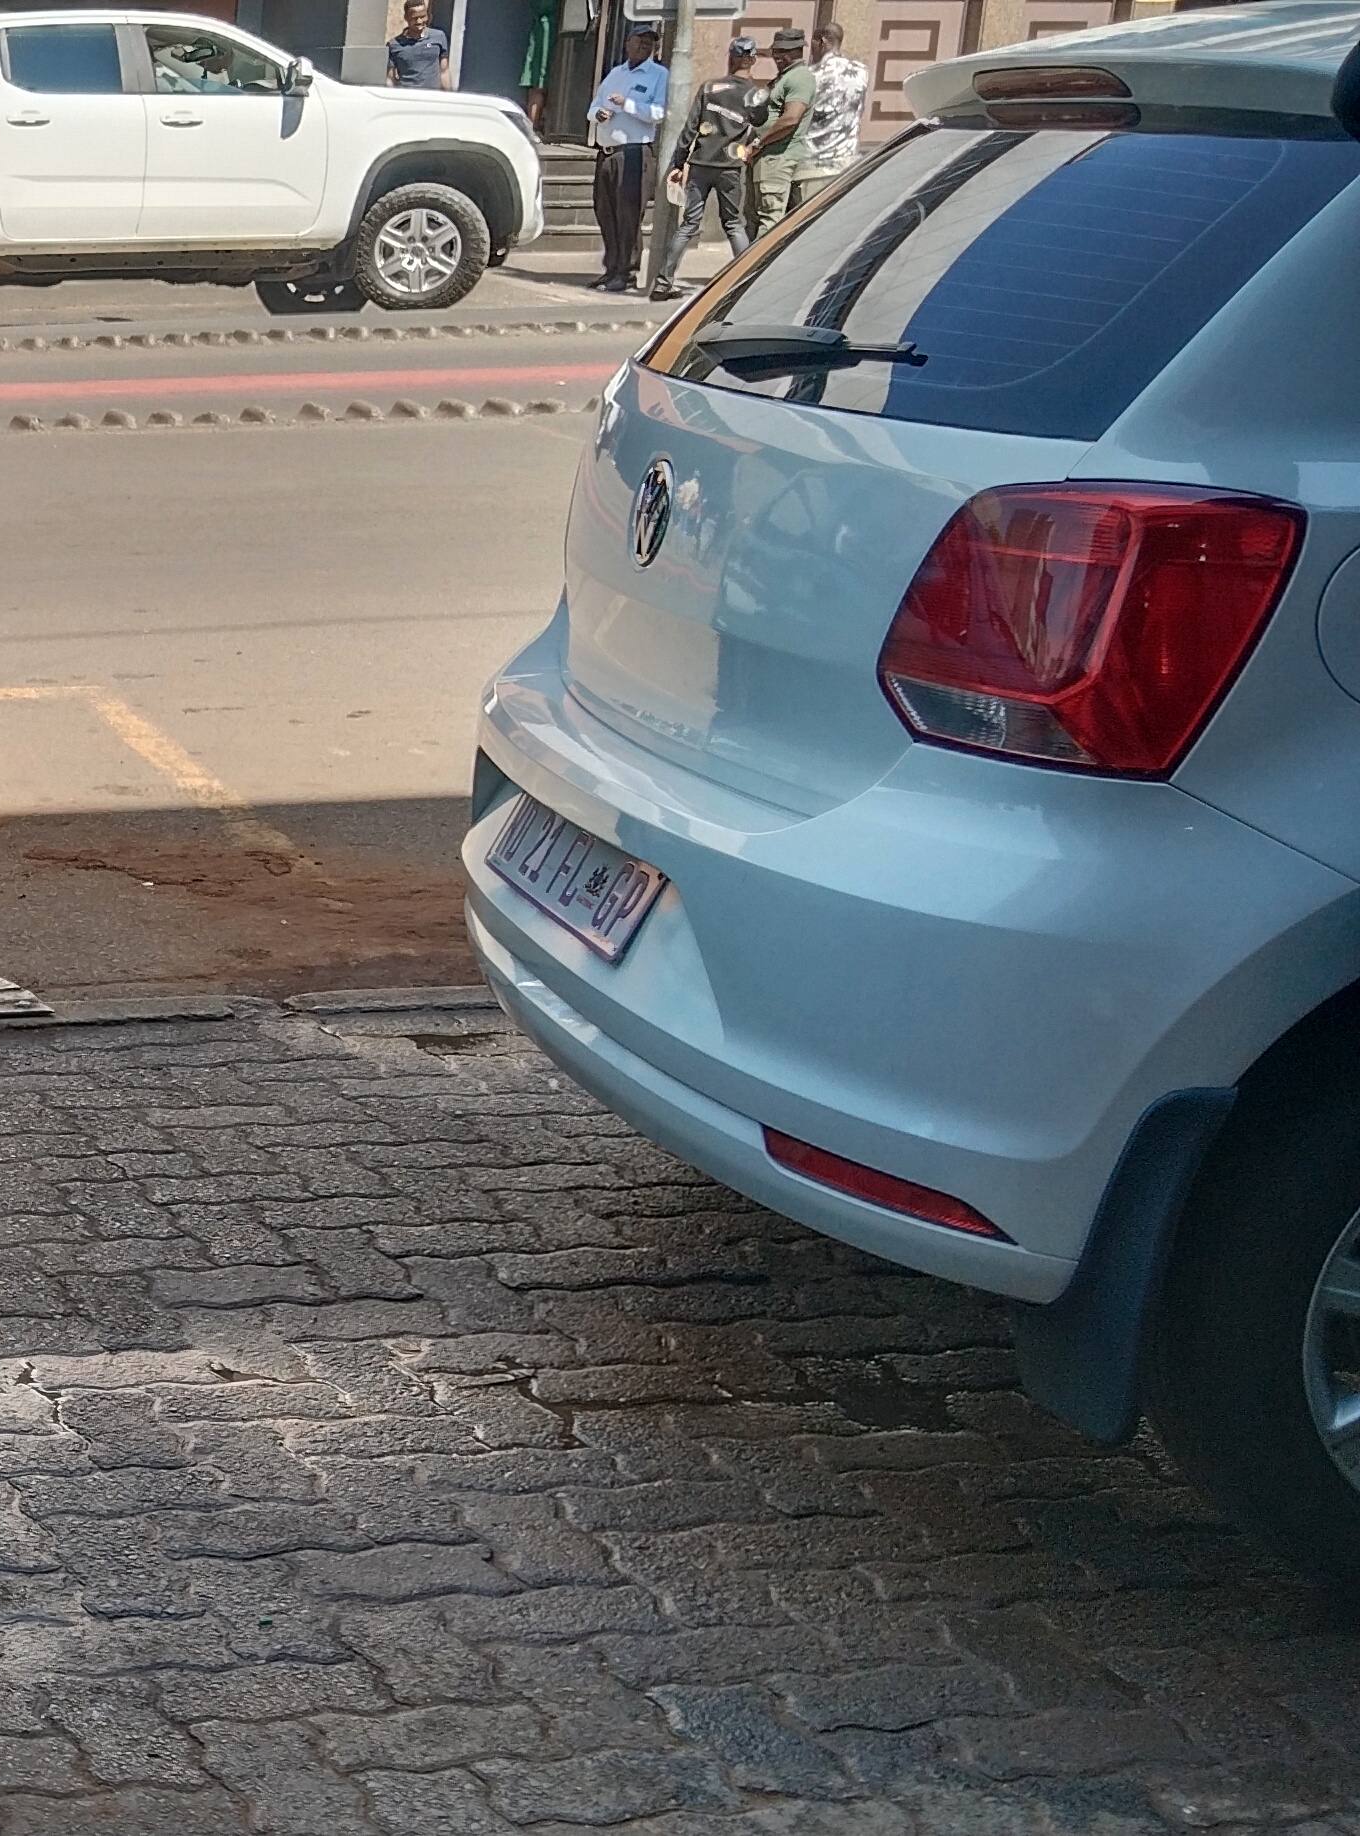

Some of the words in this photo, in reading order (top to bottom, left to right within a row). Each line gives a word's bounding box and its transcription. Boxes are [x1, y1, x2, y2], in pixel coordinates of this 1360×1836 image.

[518, 812, 567, 884] 21
[545, 830, 596, 908] FL
[591, 861, 650, 938] GP
